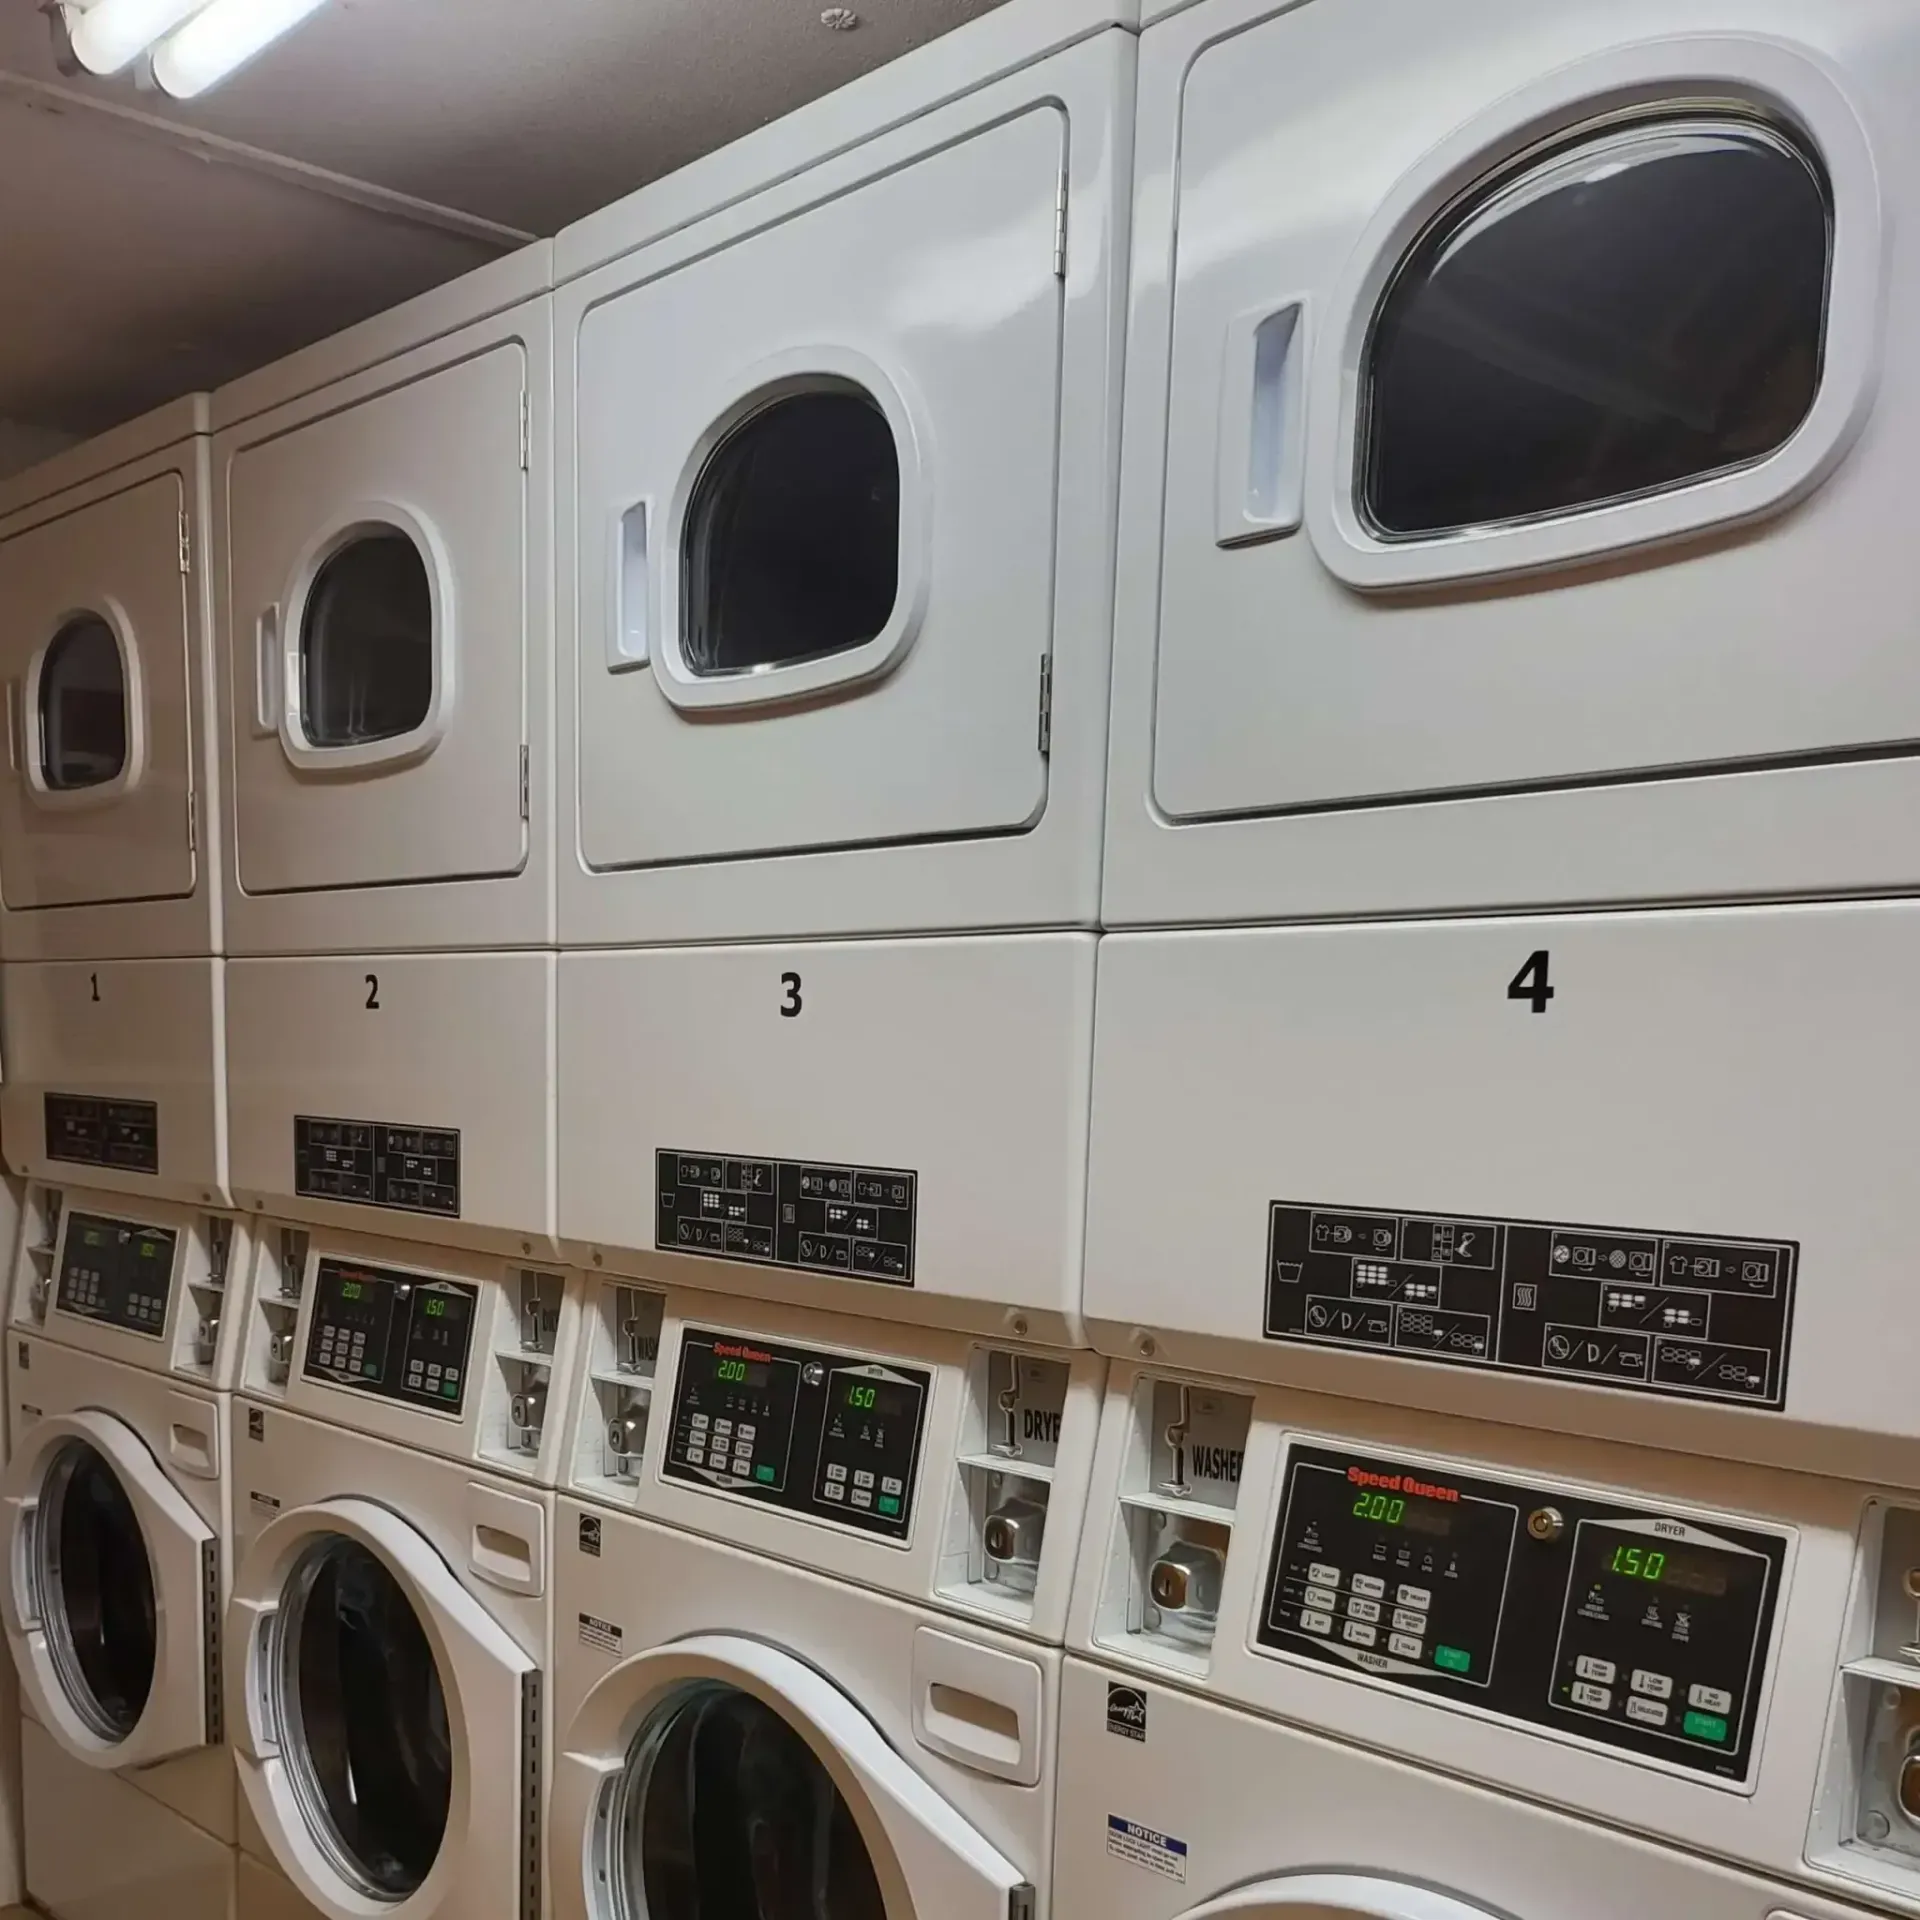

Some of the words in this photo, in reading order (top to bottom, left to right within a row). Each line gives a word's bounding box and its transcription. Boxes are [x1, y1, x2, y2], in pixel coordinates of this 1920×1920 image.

[90, 972, 100, 1001] 1
[365, 974, 380, 1009] 2
[780, 972, 802, 1017] 3
[1507, 950, 1554, 1013] 4
[1024, 1409, 1061, 1442] DRYE
[1347, 1466, 1401, 1490] Speed
[1402, 1477, 1460, 1502] Queen
[1352, 1492, 1404, 1524] 2.00
[1654, 1522, 1686, 1537] DRYER
[1612, 1546, 1665, 1579] 1.50
[1357, 1653, 1388, 1669] WASHER
[1648, 1676, 1664, 1685] LOW
[1130, 1728, 1146, 1741] STAR
[1127, 1823, 1167, 1847] NOTICE
